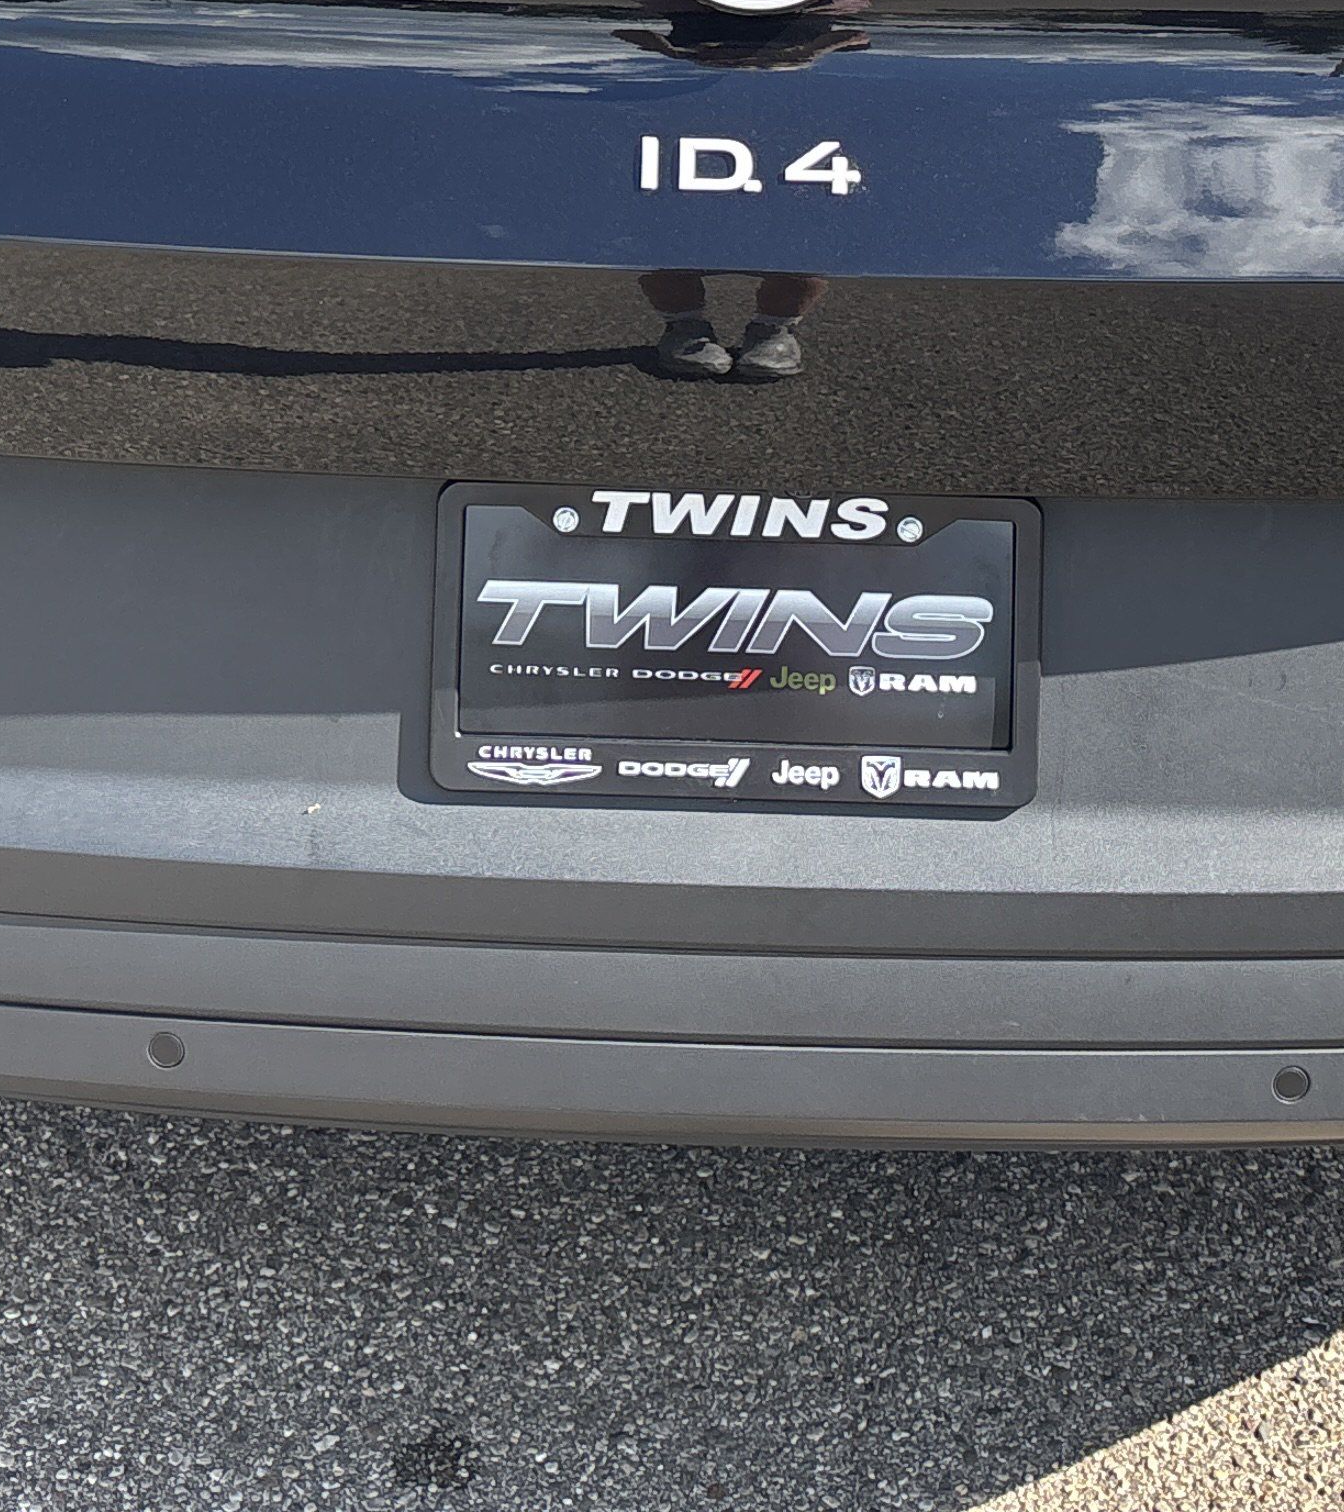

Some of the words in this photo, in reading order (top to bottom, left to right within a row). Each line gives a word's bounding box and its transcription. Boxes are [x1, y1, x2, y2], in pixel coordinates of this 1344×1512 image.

[591, 490, 890, 541] TWINS
[476, 579, 995, 660] TWINS
[489, 663, 620, 679] CHRYSLER
[632, 669, 743, 683] DODGE
[770, 666, 837, 695] Jeep
[878, 674, 978, 694] RAM
[478, 744, 593, 762] CHRYSLER
[618, 761, 732, 780] DODGE
[771, 759, 840, 788] Jeep
[903, 769, 1000, 791] RAM
